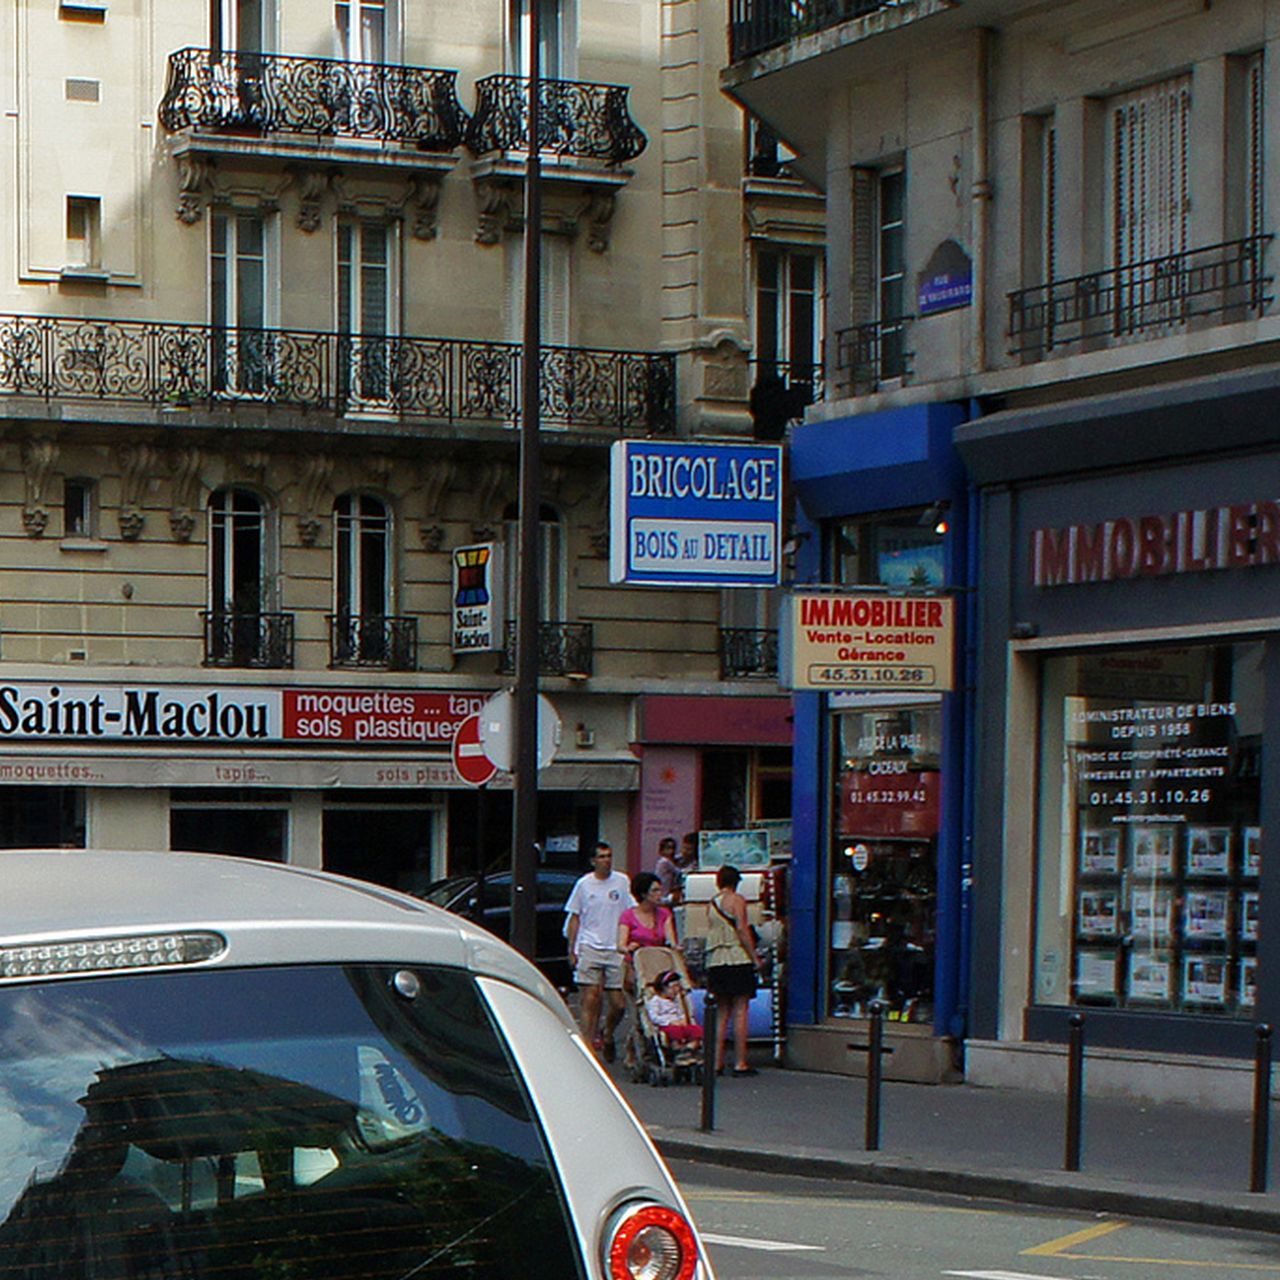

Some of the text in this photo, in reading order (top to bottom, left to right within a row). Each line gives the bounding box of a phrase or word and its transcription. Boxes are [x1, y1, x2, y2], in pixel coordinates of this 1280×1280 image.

[630, 455, 775, 501] BRICOLAGE
[634, 531, 771, 561] BOIS AU DETAIL
[1031, 499, 1280, 586] IMMOBILIER
[800, 599, 944, 628] IMMOBILIER
[837, 647, 906, 661] Gérance
[296, 693, 416, 717] moquettes
[1176, 704, 1193, 718] DE
[1197, 702, 1237, 717] BIENS
[296, 716, 343, 738] sols
[1111, 724, 1157, 739] DEPUIS
[376, 768, 410, 782] sols
[1090, 789, 1211, 806] 01.45.31.10.26
